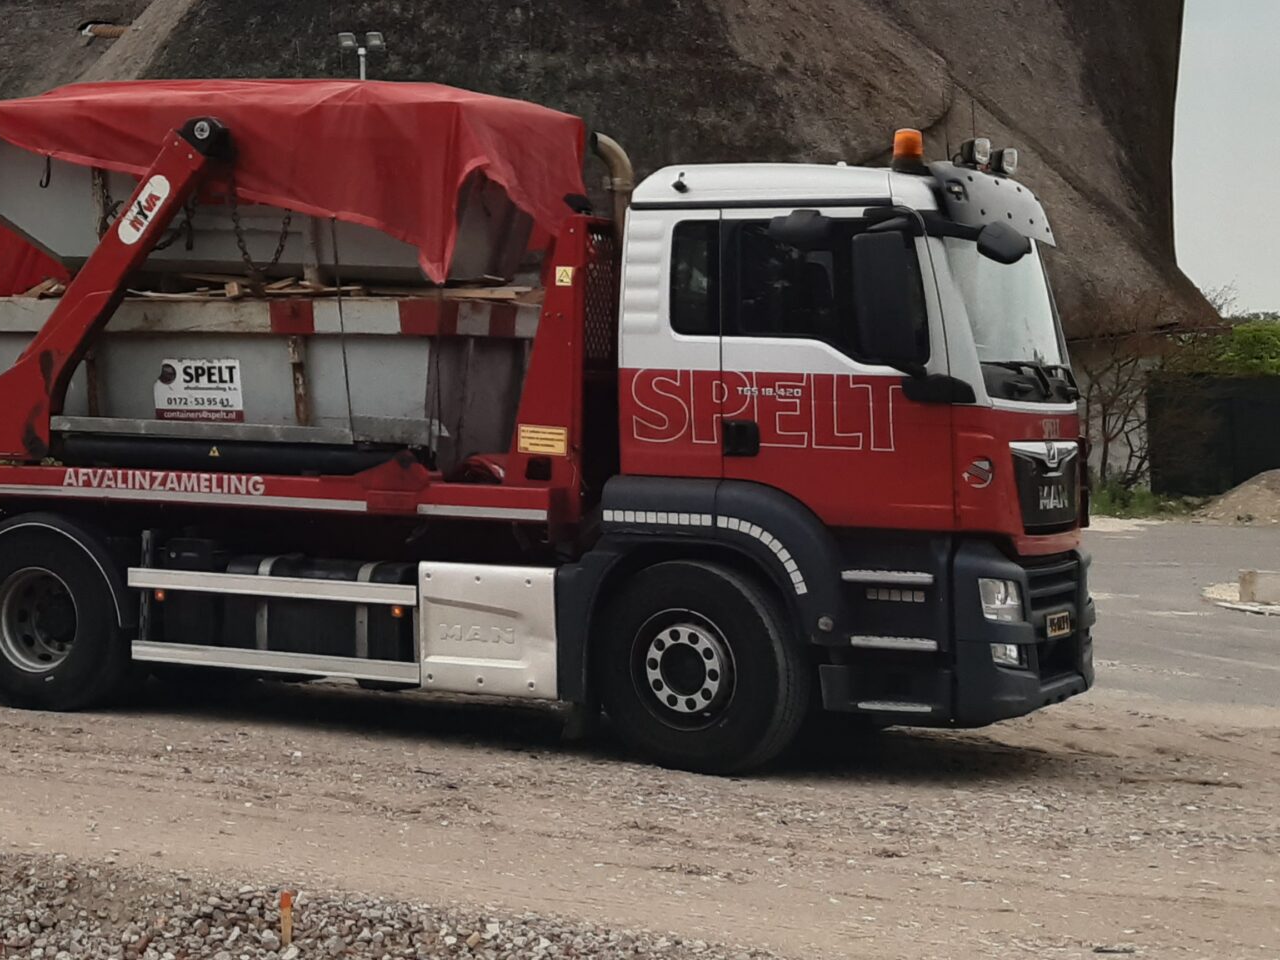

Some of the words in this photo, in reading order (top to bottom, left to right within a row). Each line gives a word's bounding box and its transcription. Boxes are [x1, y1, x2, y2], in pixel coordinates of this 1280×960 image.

[182, 365, 236, 384] SPELT
[166, 397, 188, 406] 0172
[736, 387, 759, 396] TGS
[761, 387, 802, 397] 18.420
[163, 409, 236, 420] containers@spelt.nl
[632, 367, 903, 452] SPELT
[63, 467, 266, 496] AFVALINZAMELING
[1039, 484, 1068, 510] MAN
[439, 623, 515, 645] MAN
